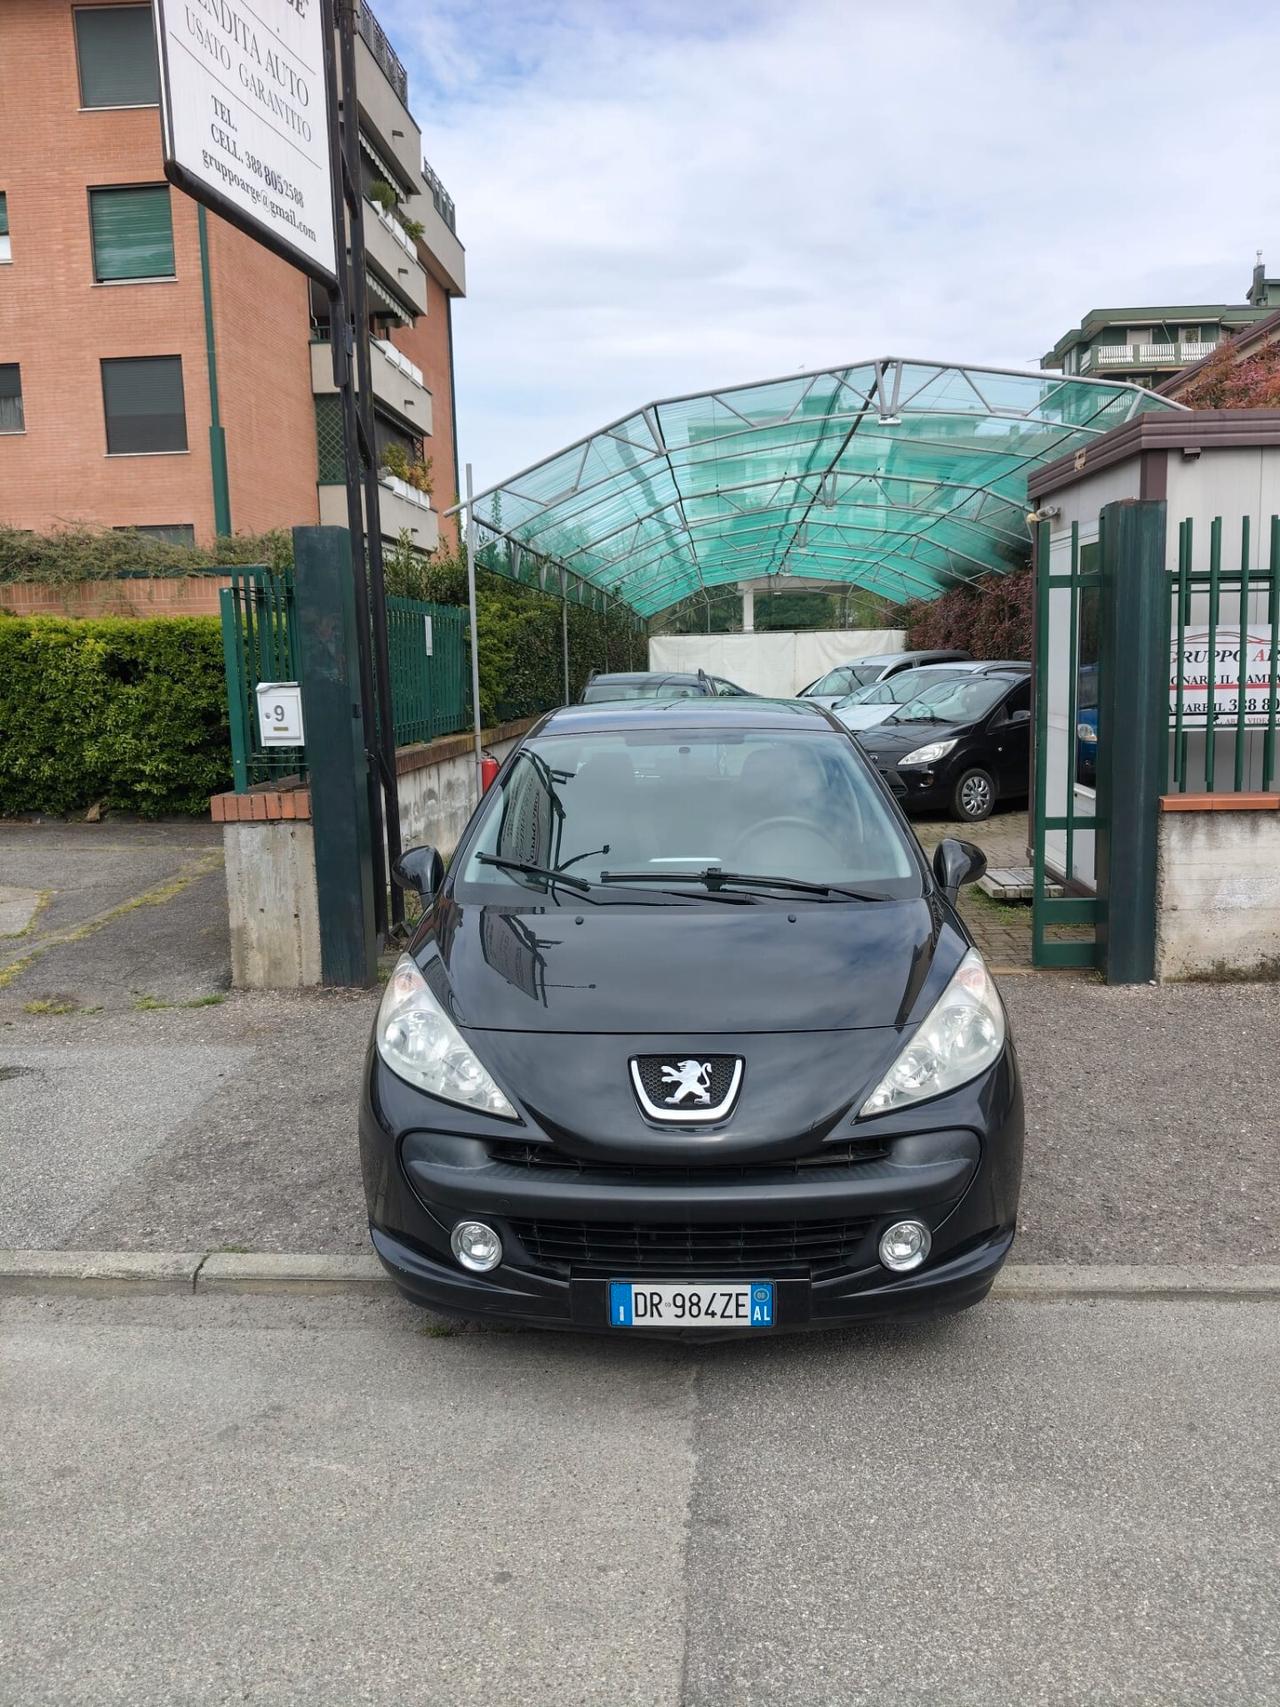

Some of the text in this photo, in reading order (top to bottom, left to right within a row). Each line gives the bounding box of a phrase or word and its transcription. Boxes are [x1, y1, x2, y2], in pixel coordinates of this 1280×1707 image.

[198, 0, 309, 107] NDITA AUTO
[185, 4, 312, 142] USATO GARANTITO
[211, 94, 238, 132] TEL.
[211, 123, 244, 163] CELL.
[245, 151, 263, 178] 388
[202, 148, 317, 242] gruppoarge@gmail.com
[1220, 674, 1234, 684] IL
[274, 704, 285, 722] 9
[1229, 698, 1257, 712] 38
[619, 1306, 625, 1321] I
[634, 1292, 749, 1319] DR 984ZE
[753, 1305, 771, 1321] AL
